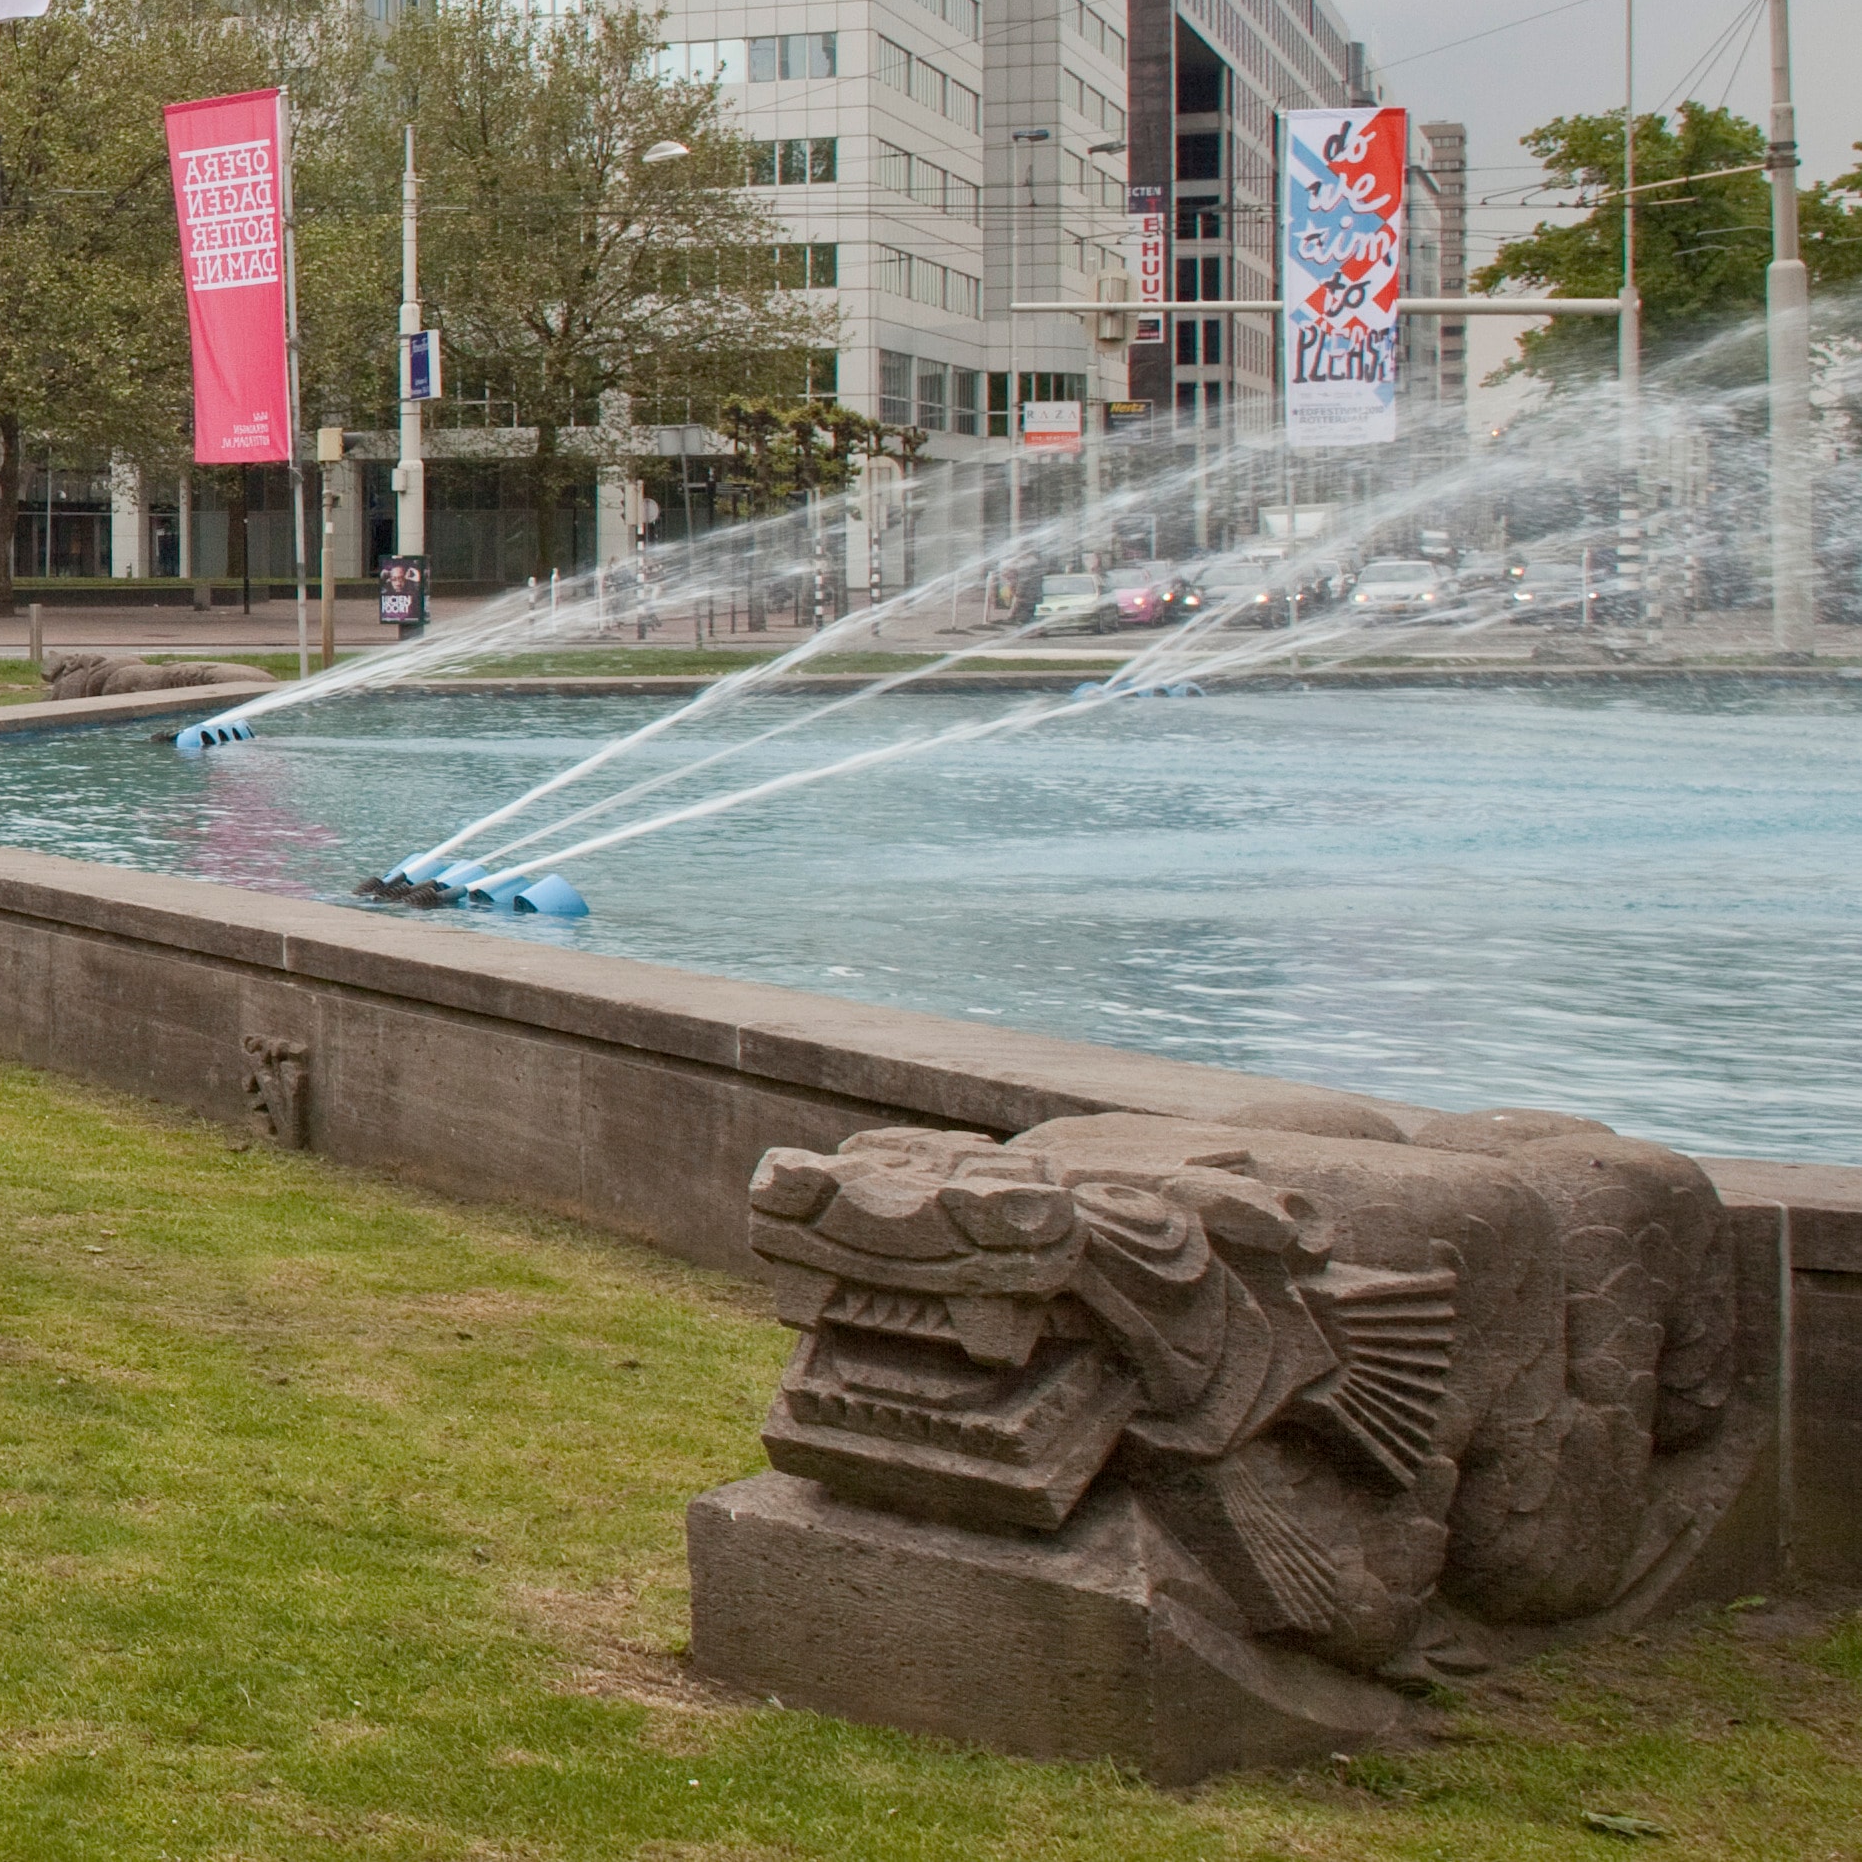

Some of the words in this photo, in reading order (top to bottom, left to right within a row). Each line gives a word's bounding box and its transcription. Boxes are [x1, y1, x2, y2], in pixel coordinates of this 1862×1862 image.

[1324, 121, 1377, 163] do
[1307, 172, 1392, 214] we
[1297, 216, 1393, 267] aim
[1142, 241, 1160, 303] HUU
[1325, 271, 1372, 318] to
[1110, 402, 1147, 413] Hertz
